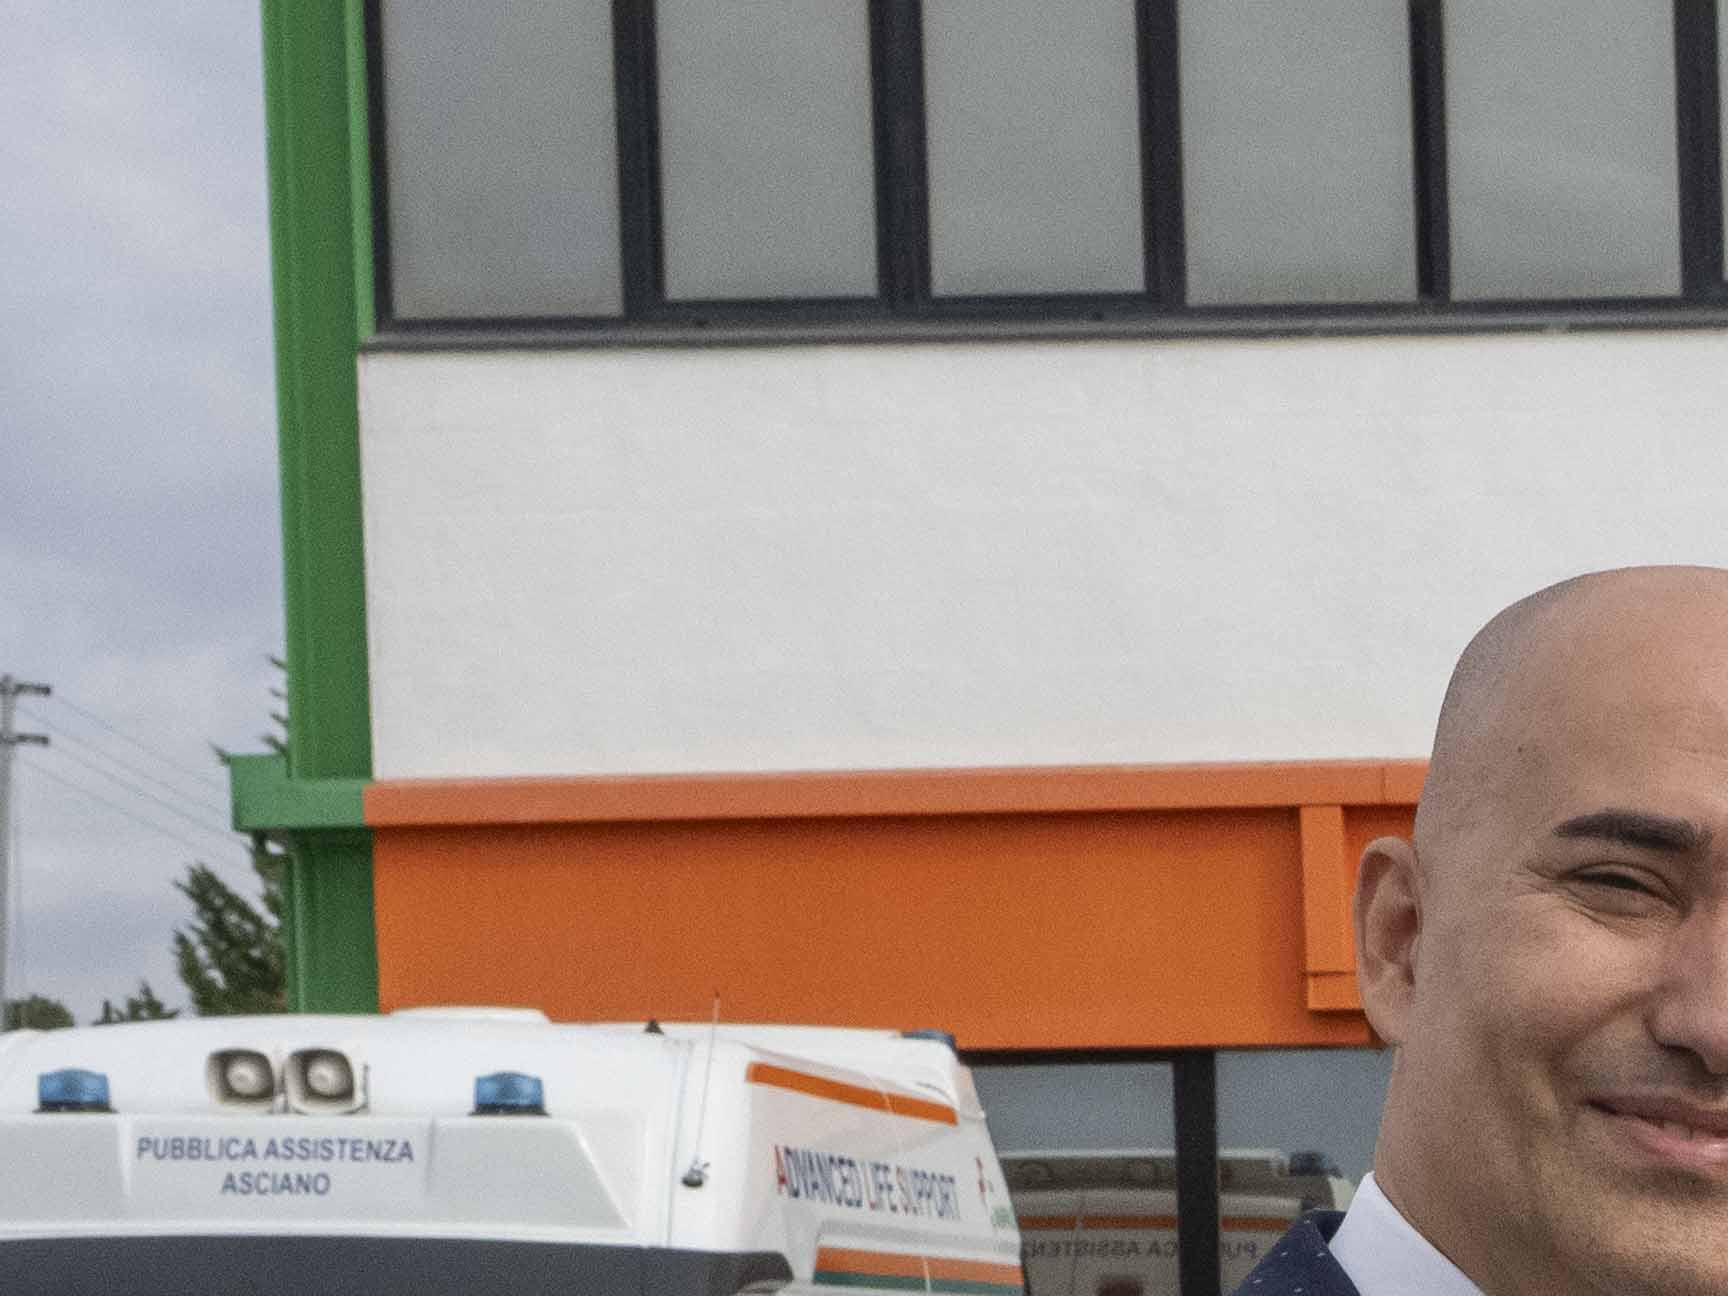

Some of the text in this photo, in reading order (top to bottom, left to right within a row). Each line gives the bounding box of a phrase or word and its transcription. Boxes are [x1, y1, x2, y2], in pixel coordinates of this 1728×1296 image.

[137, 1137, 414, 1162] PUBBLICA ASSISTENZA
[221, 1171, 331, 1196] ASCIANO
[775, 1144, 863, 1208] ADVANCED
[863, 1161, 897, 1213] LIFE
[896, 1166, 961, 1221] SUPPORT
